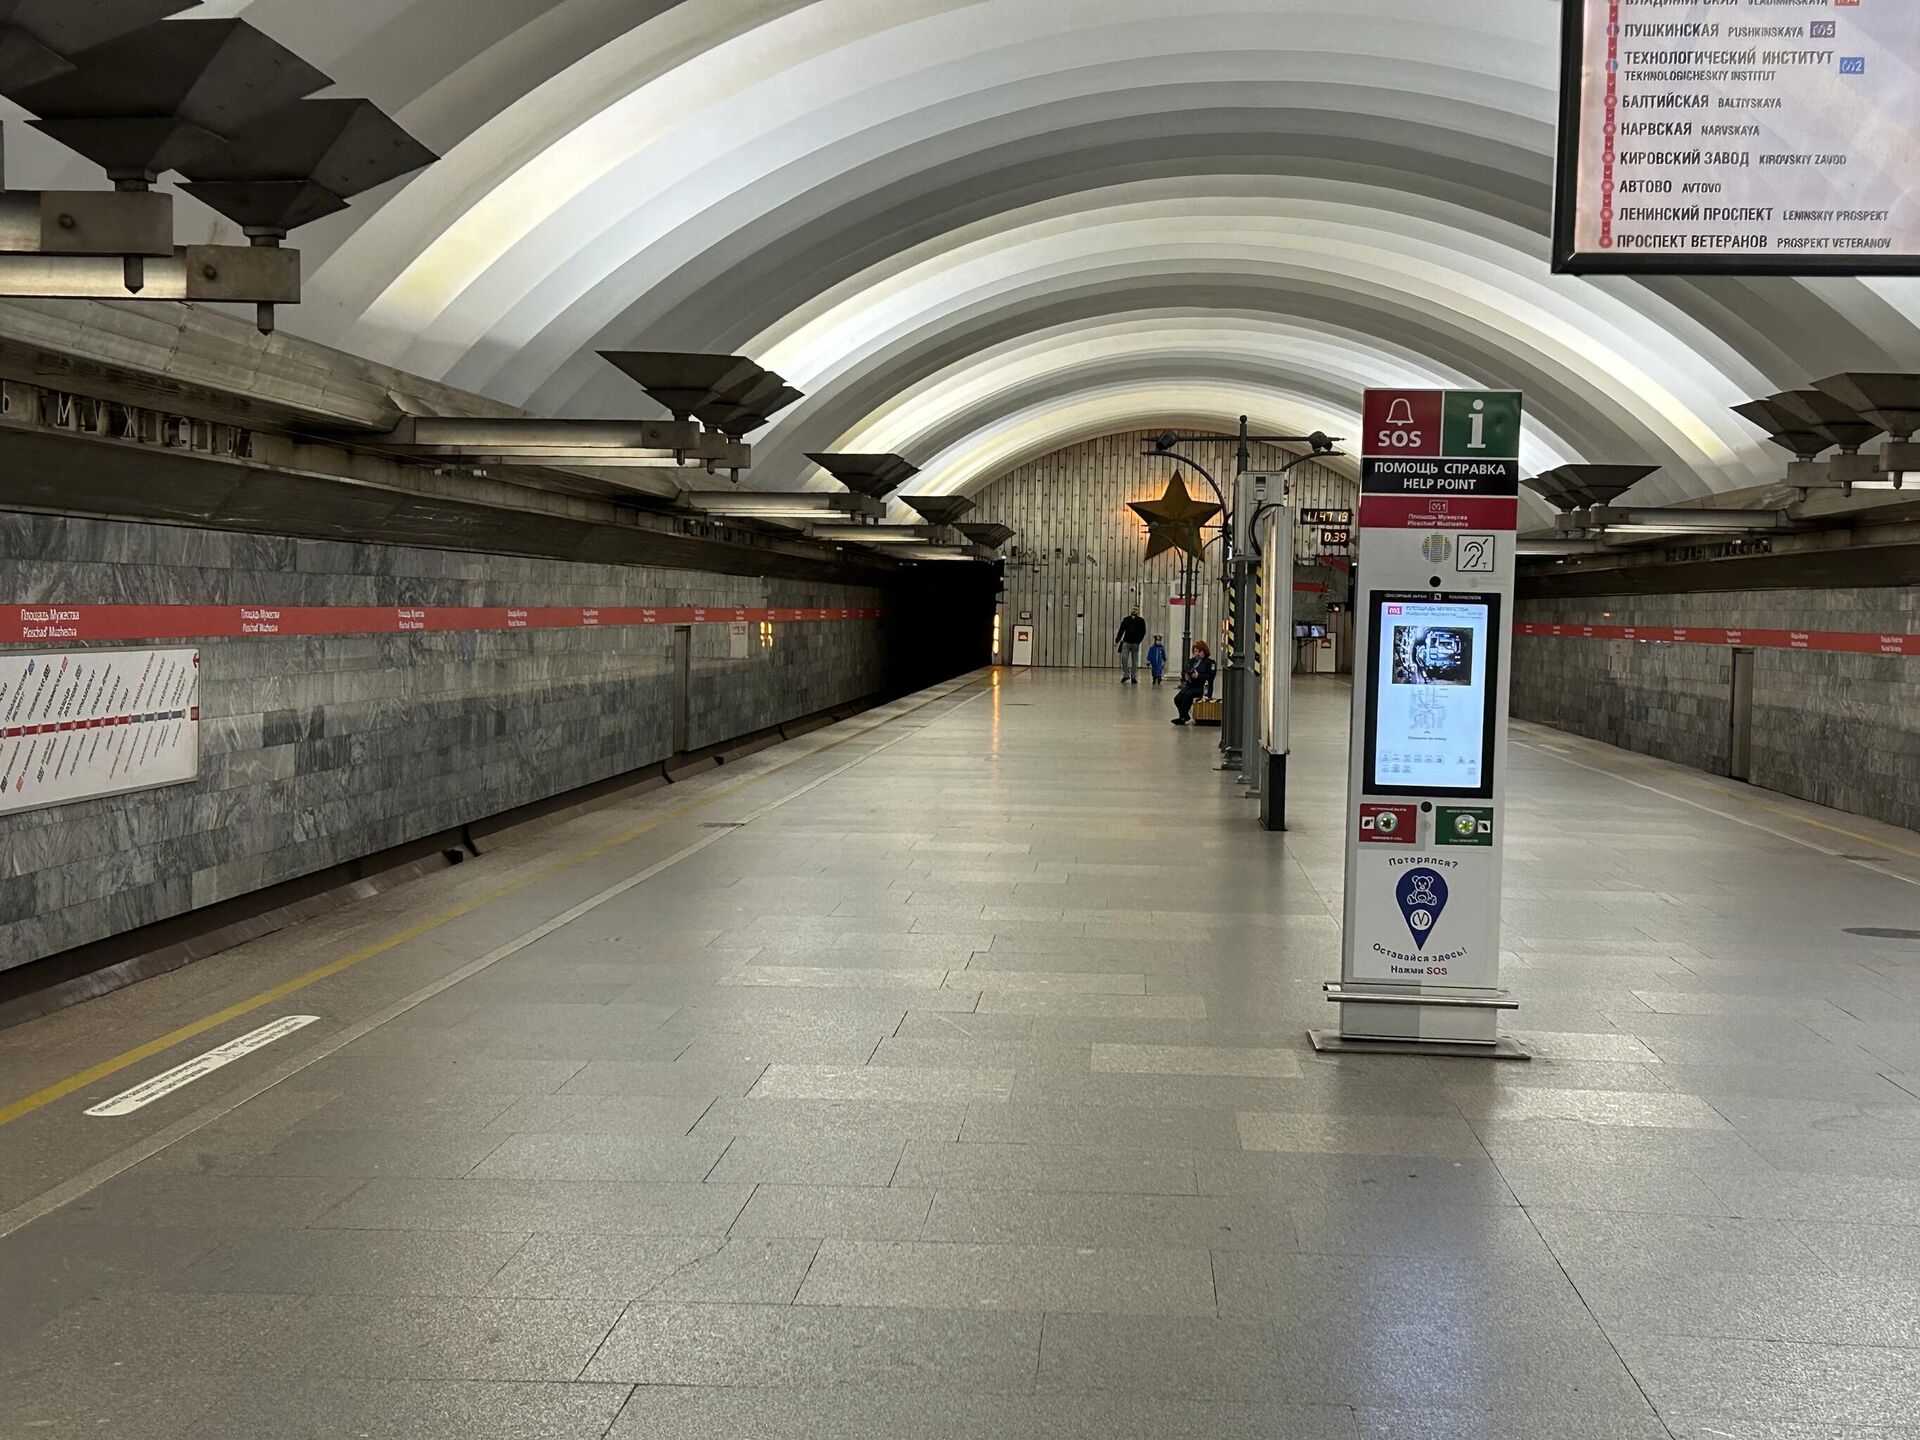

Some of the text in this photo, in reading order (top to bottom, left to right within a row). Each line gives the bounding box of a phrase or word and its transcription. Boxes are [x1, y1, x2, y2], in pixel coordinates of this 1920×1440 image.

[1624, 23, 1719, 37] ПУШКИНСКАЯ
[1728, 26, 1804, 37] PUSHKINSKAYA
[1624, 47, 1834, 65] ТЕХНОЛОГИЧЕСКИЙ ИНСТИТУТ
[1624, 70, 1776, 81] TEKHNOLOGICHESKIY INSTITUT
[1622, 92, 1782, 108] БАЛТИЙСКАЯ BALTIYSKAYA
[1621, 122, 1760, 136] НАРВСКАЯ NARVSKAYA
[1620, 149, 1846, 167] КИРОВСКИЙ ЗАВОД KIROVSKIY ZAVOD
[1619, 179, 1721, 193] АВТОВО AVTOVO
[1619, 205, 1888, 221] ЛЕНИНСКИЙ ПРОСПЕКТ LENINSKIY PROSPEKT
[1617, 234, 1891, 248] ПРОСПЕКТ ВЕТЕРАНОВ PROSPEKT VETERANOV
[1378, 430, 1422, 448] SOS
[1374, 462, 1506, 475] ПОМОЩЬ СПРАВКА
[1403, 478, 1477, 490] HELP POINT
[1388, 856, 1459, 869] Потерялся?
[1373, 943, 1468, 962] Оставайся здесь!
[1390, 965, 1448, 975] Нажми SOS
